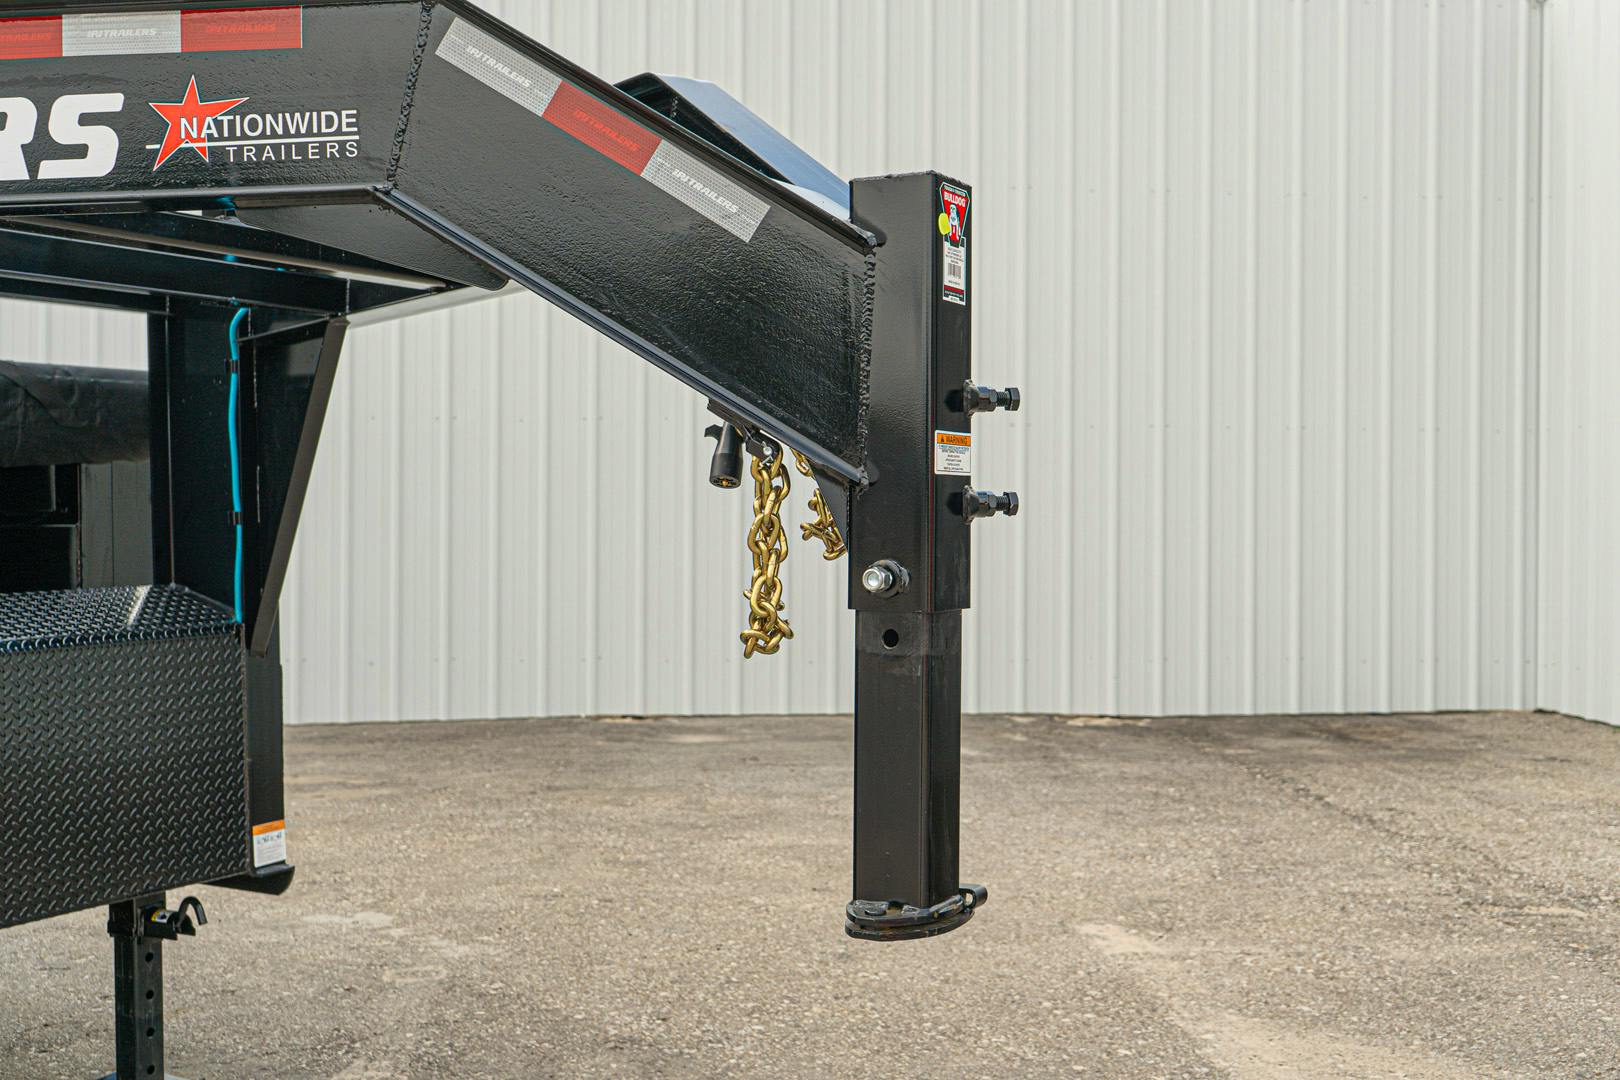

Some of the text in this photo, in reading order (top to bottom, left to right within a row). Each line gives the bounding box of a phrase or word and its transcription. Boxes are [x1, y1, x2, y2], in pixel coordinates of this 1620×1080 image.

[180, 109, 358, 139] NATIONWIDE
[226, 141, 359, 162] TRAILERS
[944, 191, 966, 208] BULLDOG
[945, 435, 967, 445] WARNING
